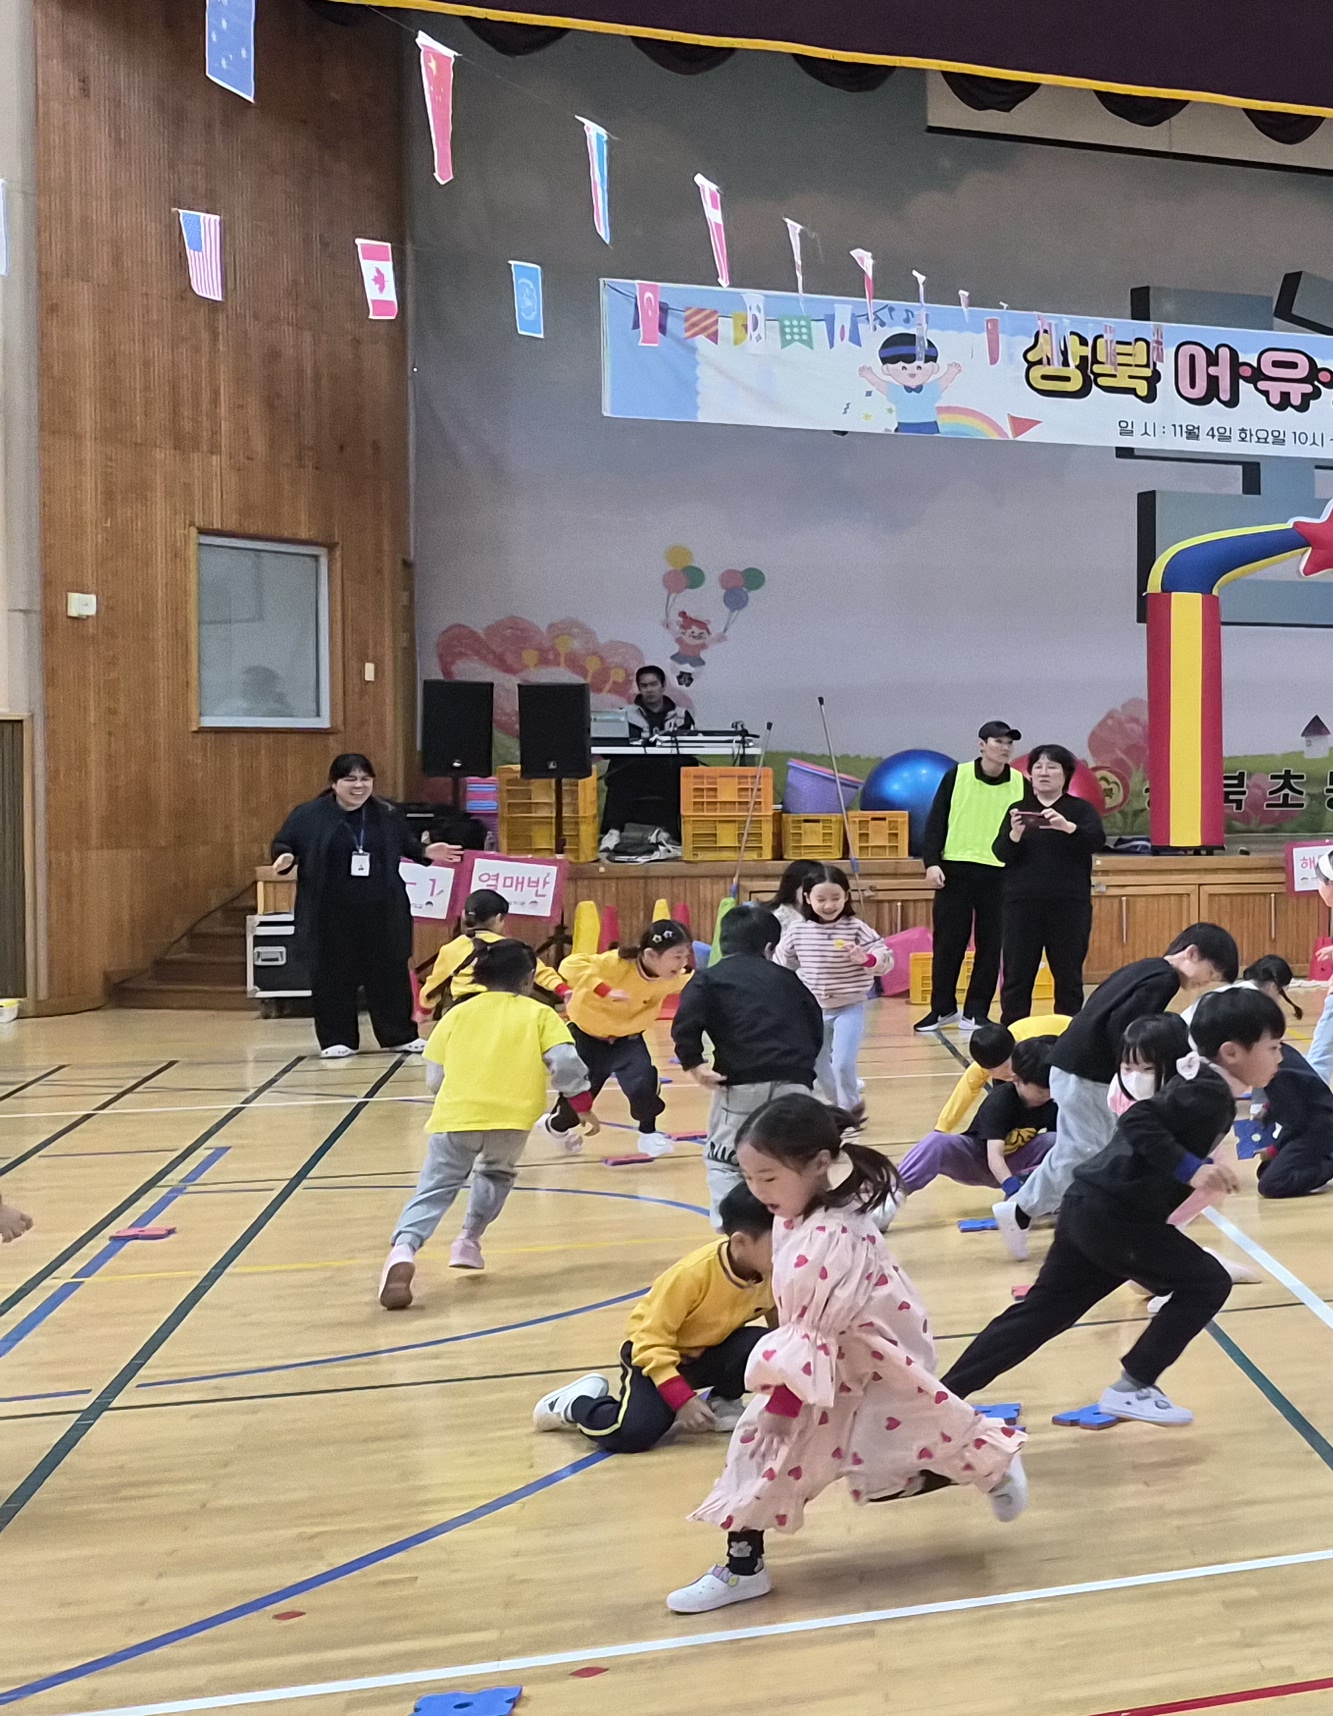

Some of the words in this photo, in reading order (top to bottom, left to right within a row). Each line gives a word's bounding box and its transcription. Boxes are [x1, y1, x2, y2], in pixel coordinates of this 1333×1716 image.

[1023, 329, 1162, 404] 상북
[1118, 420, 1134, 437] 일
[1140, 421, 1156, 438] 시
[1171, 423, 1201, 442] 11월
[1206, 426, 1232, 443] 4일
[1237, 427, 1286, 446] 화요일
[1292, 431, 1324, 448] 10시
